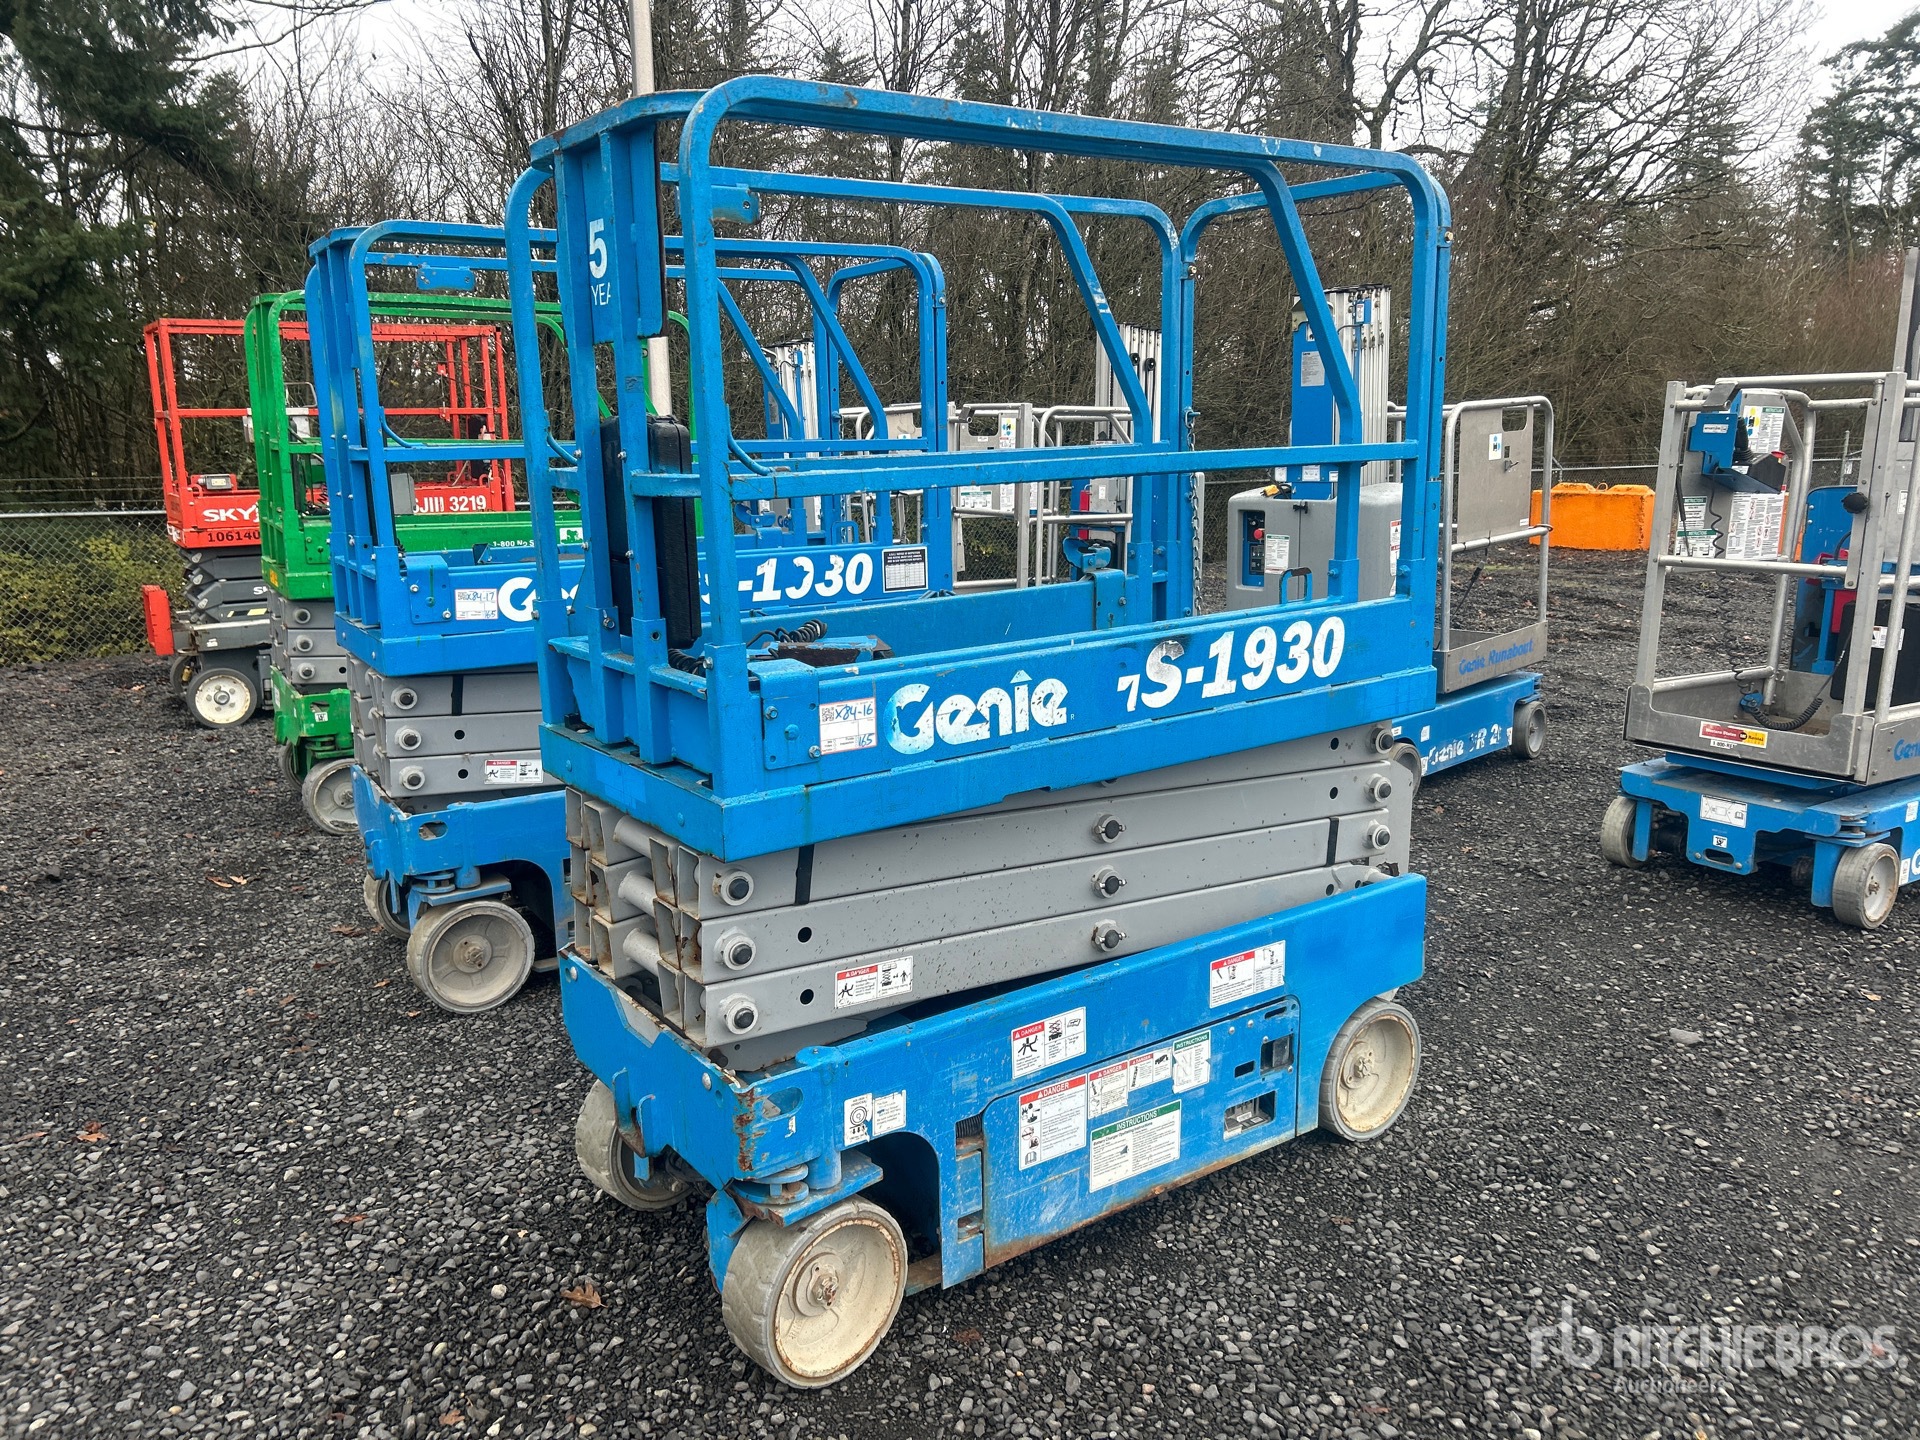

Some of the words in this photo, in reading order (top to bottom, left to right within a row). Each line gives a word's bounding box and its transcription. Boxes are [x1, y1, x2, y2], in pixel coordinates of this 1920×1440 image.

[589, 218, 607, 278] 5
[449, 494, 487, 512] 3219
[883, 670, 1068, 755] Genie
[1021, 1024, 1043, 1036] DANGER
[1175, 1034, 1208, 1050] INSTRUCTIONS
[1103, 1065, 1123, 1076] DANGER
[1043, 1082, 1070, 1097] DANGER
[1116, 1110, 1158, 1131] INSTRUCTIONS
